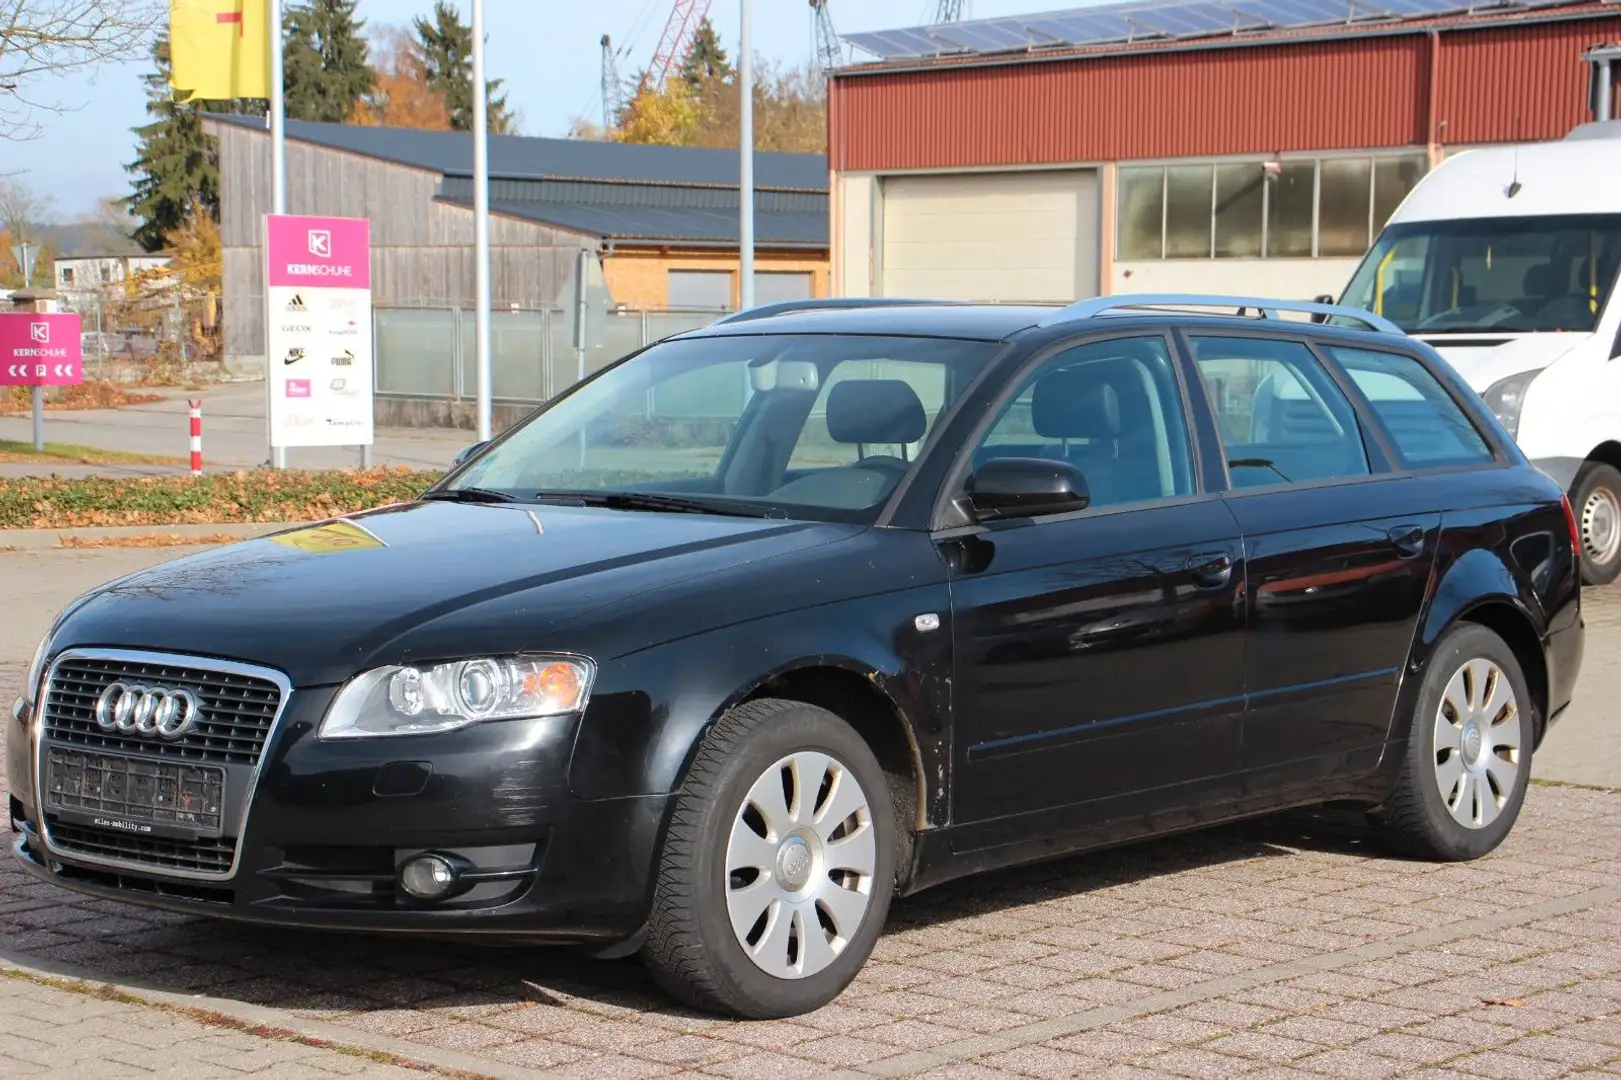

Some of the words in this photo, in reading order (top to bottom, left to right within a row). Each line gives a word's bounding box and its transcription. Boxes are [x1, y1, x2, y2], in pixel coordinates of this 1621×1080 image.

[287, 263, 353, 277] KERNSCHUHE
[13, 348, 68, 357] KERNSCHUHE
[331, 357, 352, 366] PUMA
[94, 817, 151, 832] miles-mobility.com
